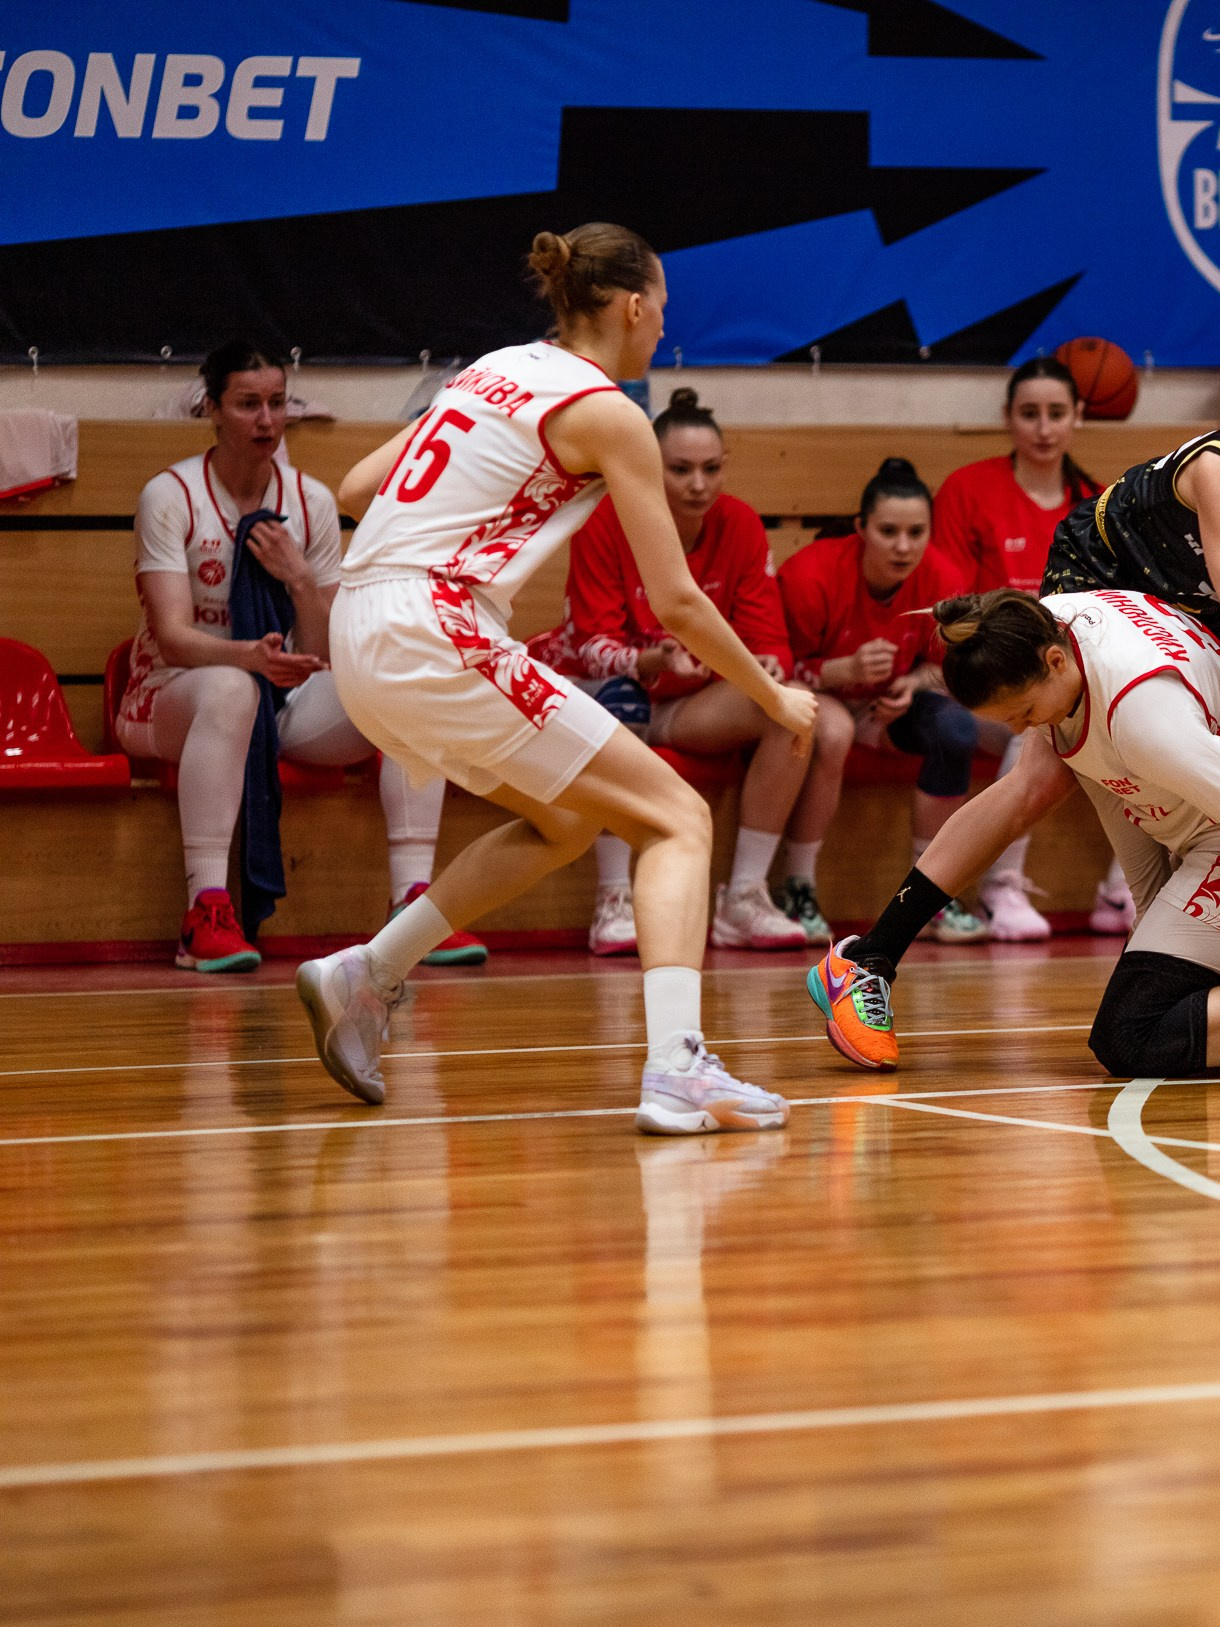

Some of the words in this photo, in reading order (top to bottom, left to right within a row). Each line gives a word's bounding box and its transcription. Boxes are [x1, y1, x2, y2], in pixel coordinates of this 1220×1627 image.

[0, 49, 361, 142] ONBET
[377, 405, 476, 503] 15
[1101, 777, 1133, 788] FON
[1112, 784, 1141, 795] BET
